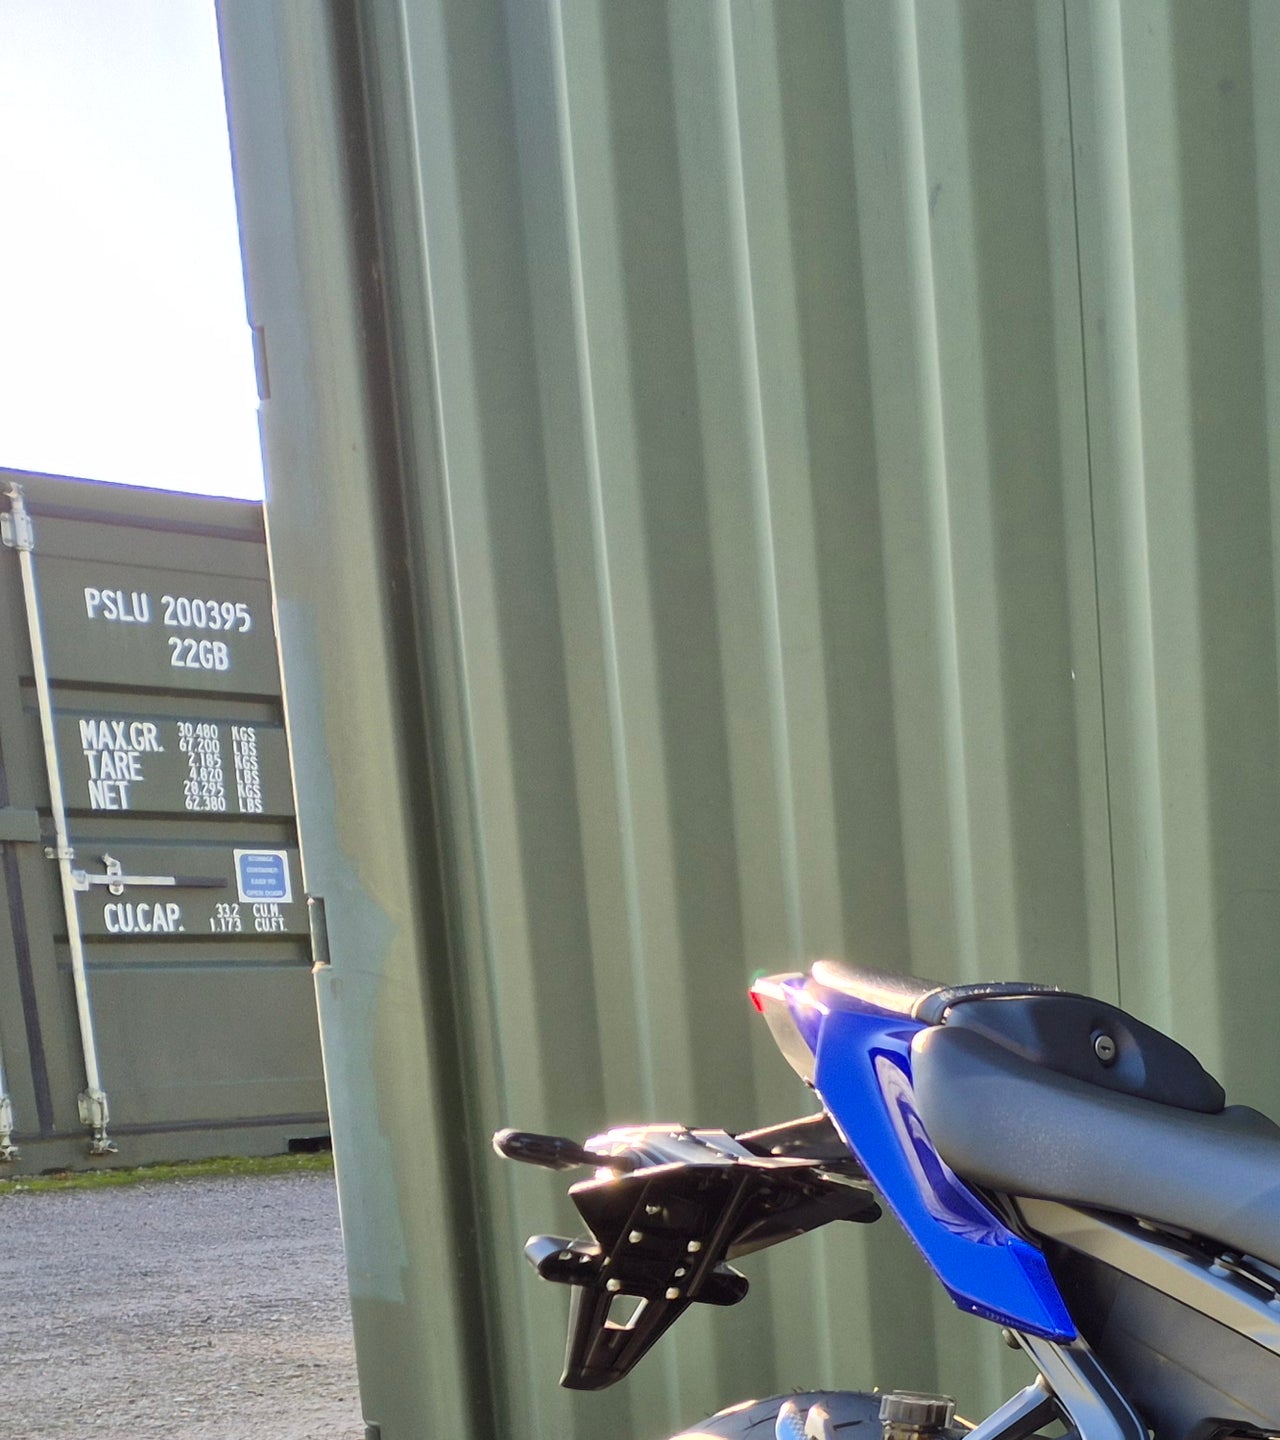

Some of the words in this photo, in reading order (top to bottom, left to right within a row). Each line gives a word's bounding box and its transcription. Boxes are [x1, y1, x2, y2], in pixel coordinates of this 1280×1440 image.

[83, 587, 150, 623] PSLU
[160, 595, 251, 633] 200395
[168, 636, 230, 671] 22GB
[79, 719, 165, 753] MAX.GR.
[177, 721, 218, 738] 30.480
[231, 725, 256, 741] KGS
[179, 737, 220, 753] 67.200
[233, 740, 257, 756] LBS
[83, 750, 144, 781] TARE
[188, 752, 222, 767] 2.185
[234, 754, 259, 770] KGS
[236, 768, 260, 784] LBS
[88, 780, 130, 810] NET
[237, 783, 262, 798] KGS
[185, 795, 226, 811] 62.380
[239, 798, 263, 814] LBS
[103, 902, 186, 932] CU.CAP.
